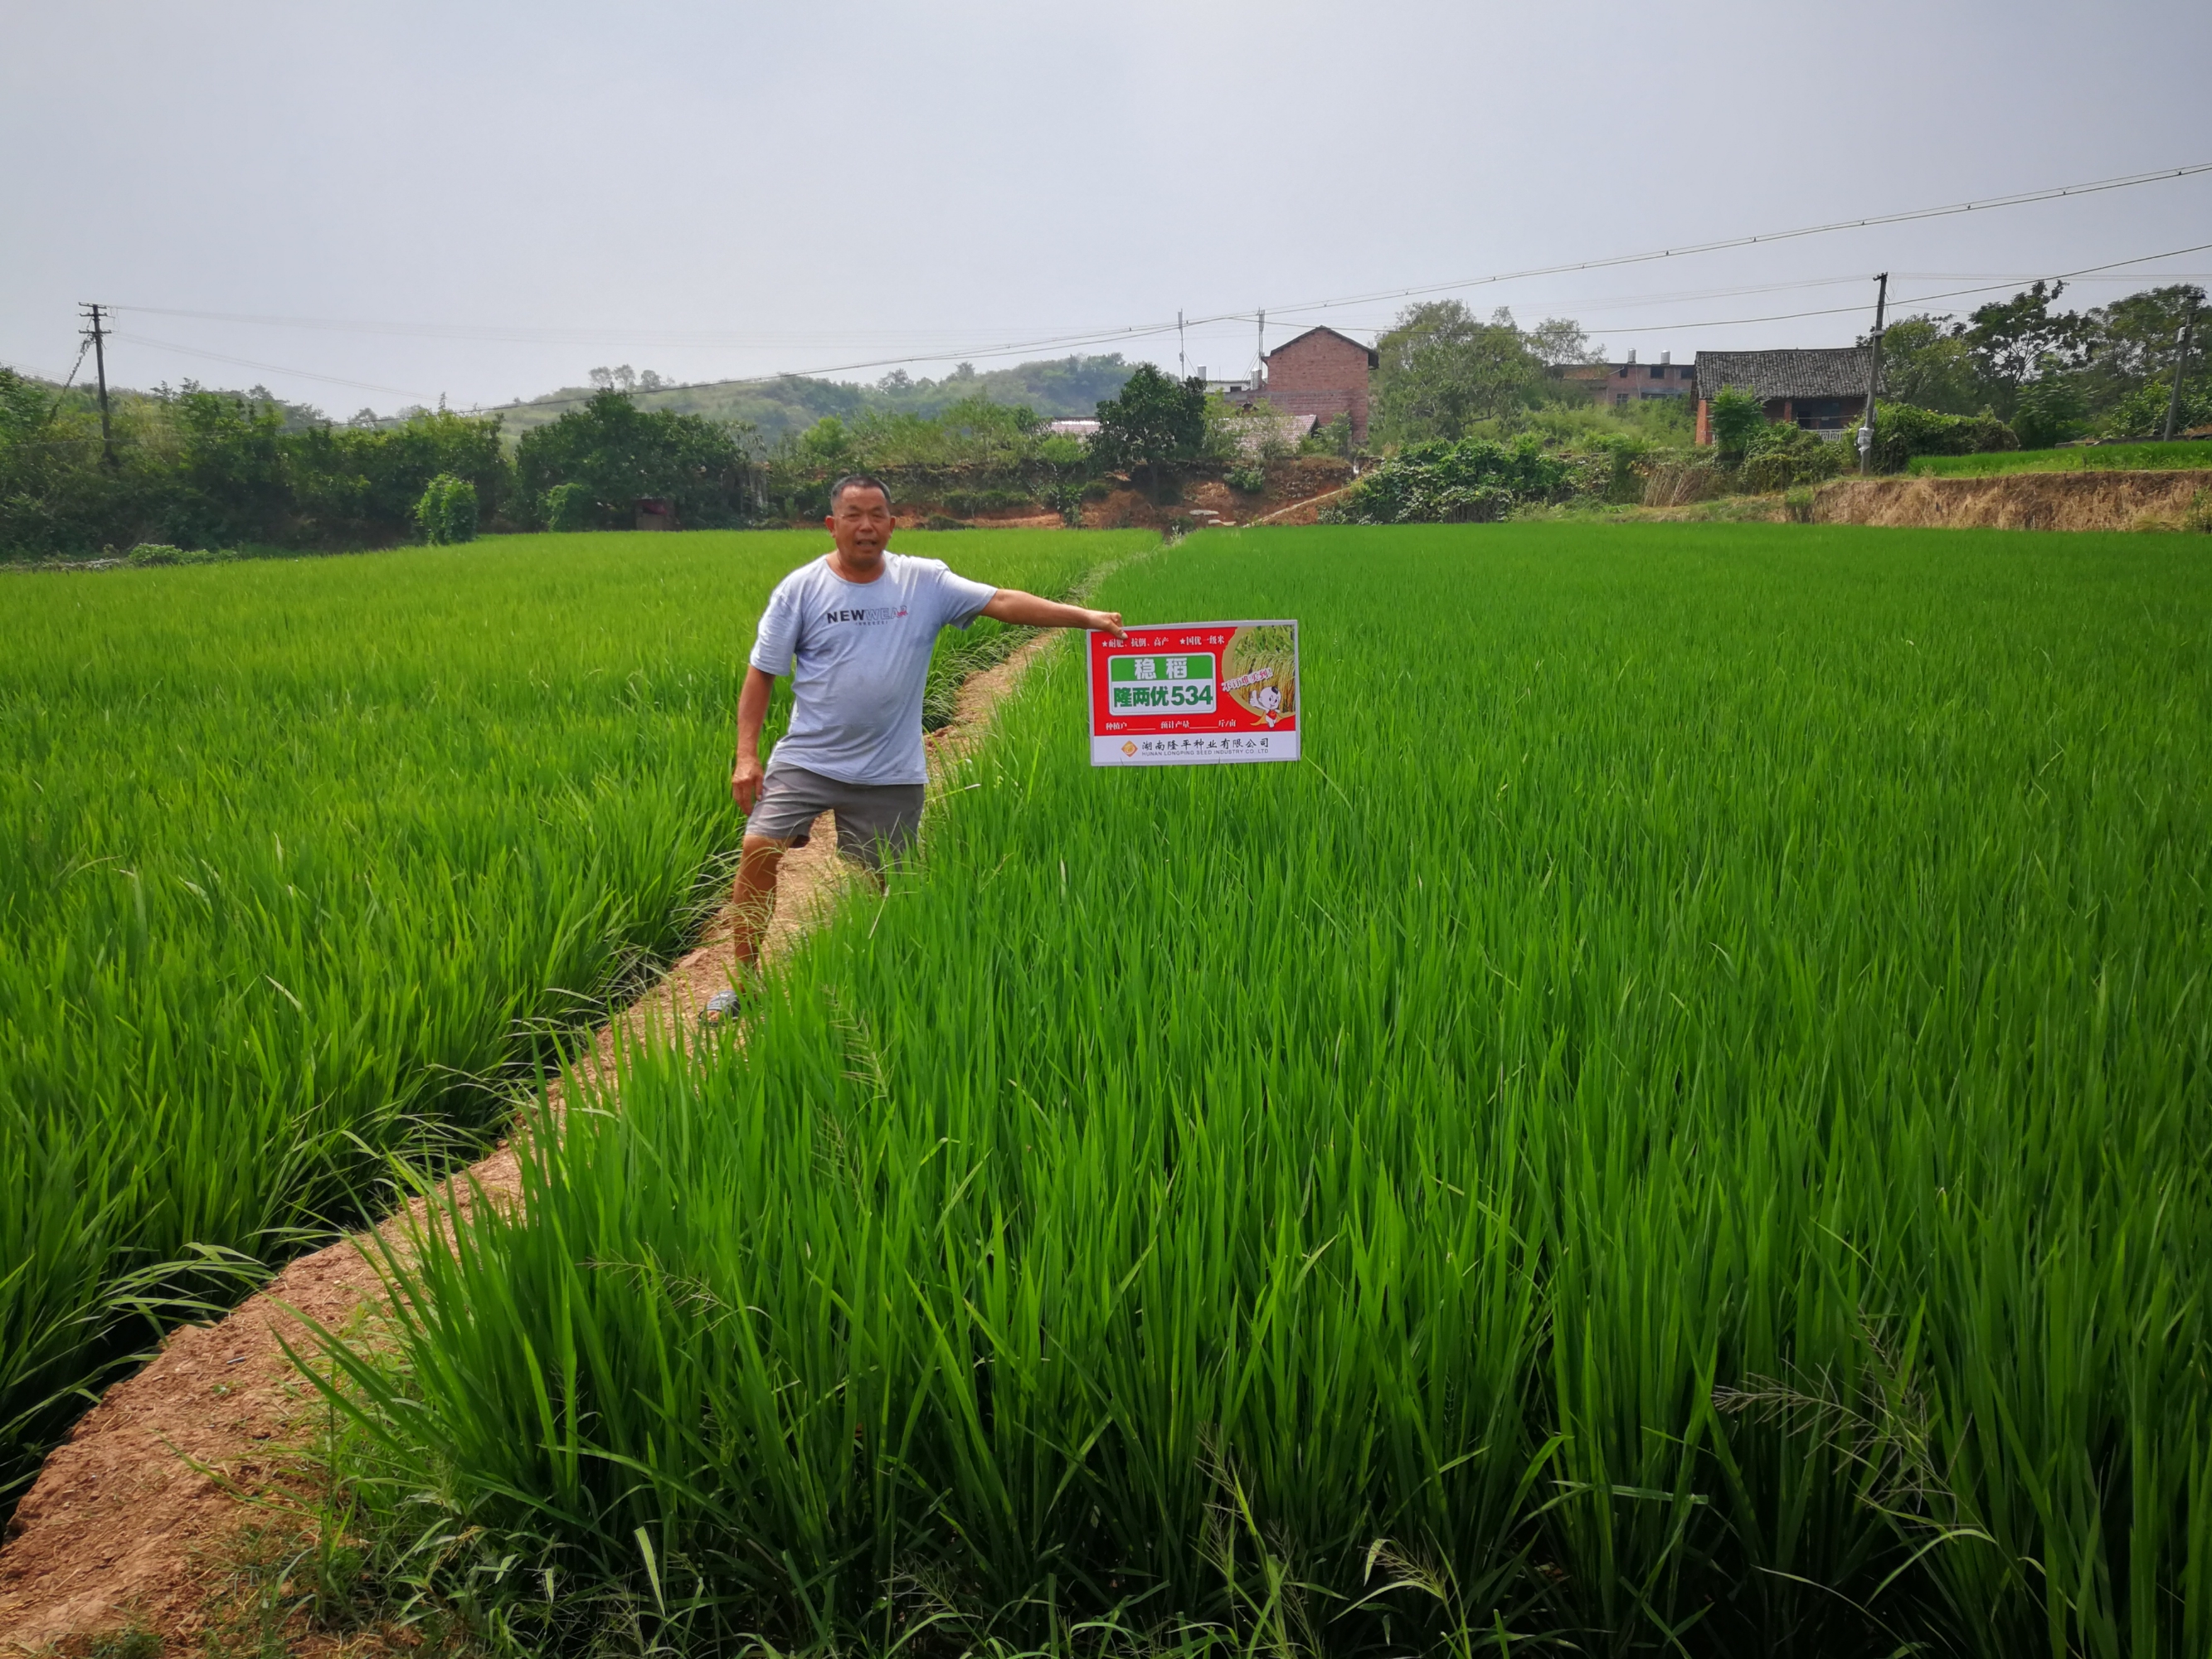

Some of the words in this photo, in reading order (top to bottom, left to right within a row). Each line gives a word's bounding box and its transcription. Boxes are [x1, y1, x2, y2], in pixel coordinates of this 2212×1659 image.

[1114, 685, 1213, 708] 隆两优534
[1141, 737, 1269, 751] 湖南隆平种业有限公司
